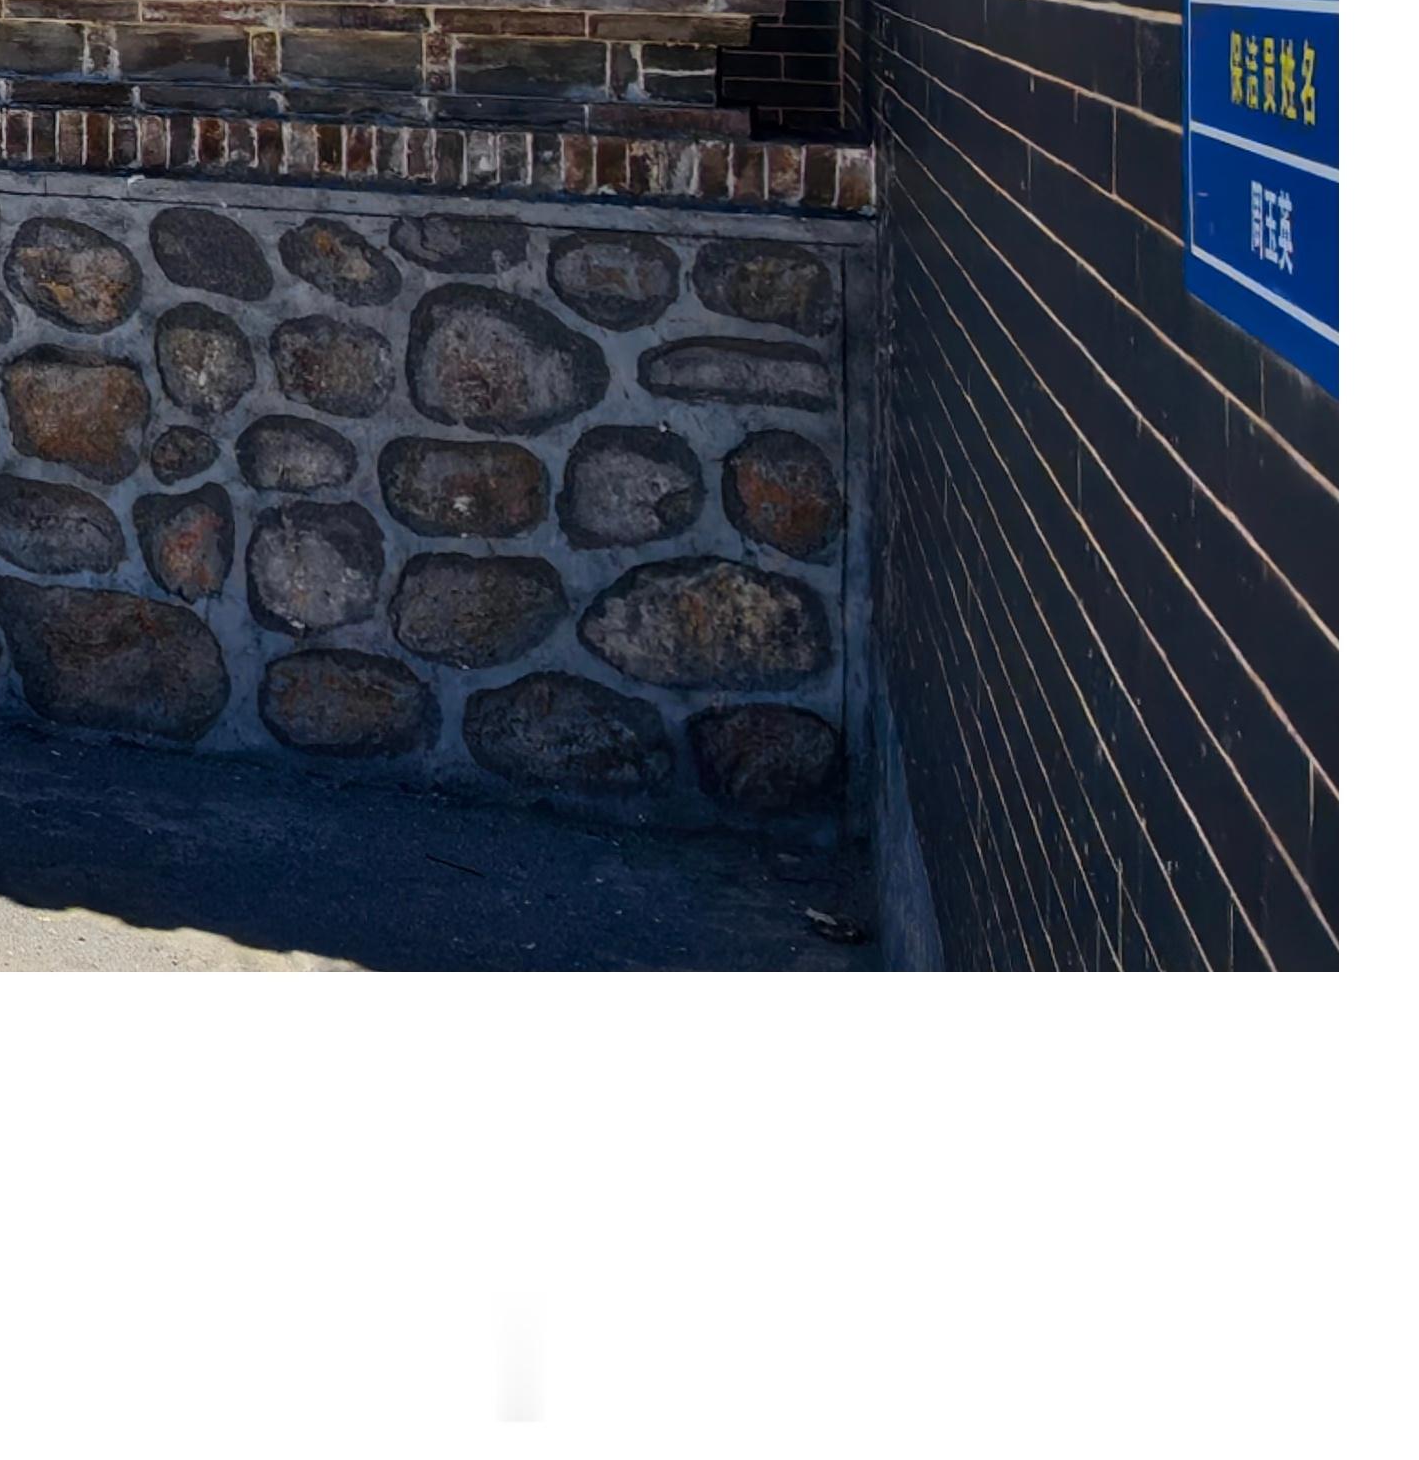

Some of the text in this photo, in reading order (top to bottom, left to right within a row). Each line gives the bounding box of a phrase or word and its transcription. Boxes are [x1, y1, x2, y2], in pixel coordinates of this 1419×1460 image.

[1230, 30, 1316, 126] 保洁员姓名
[1250, 179, 1294, 275] 周玉英
